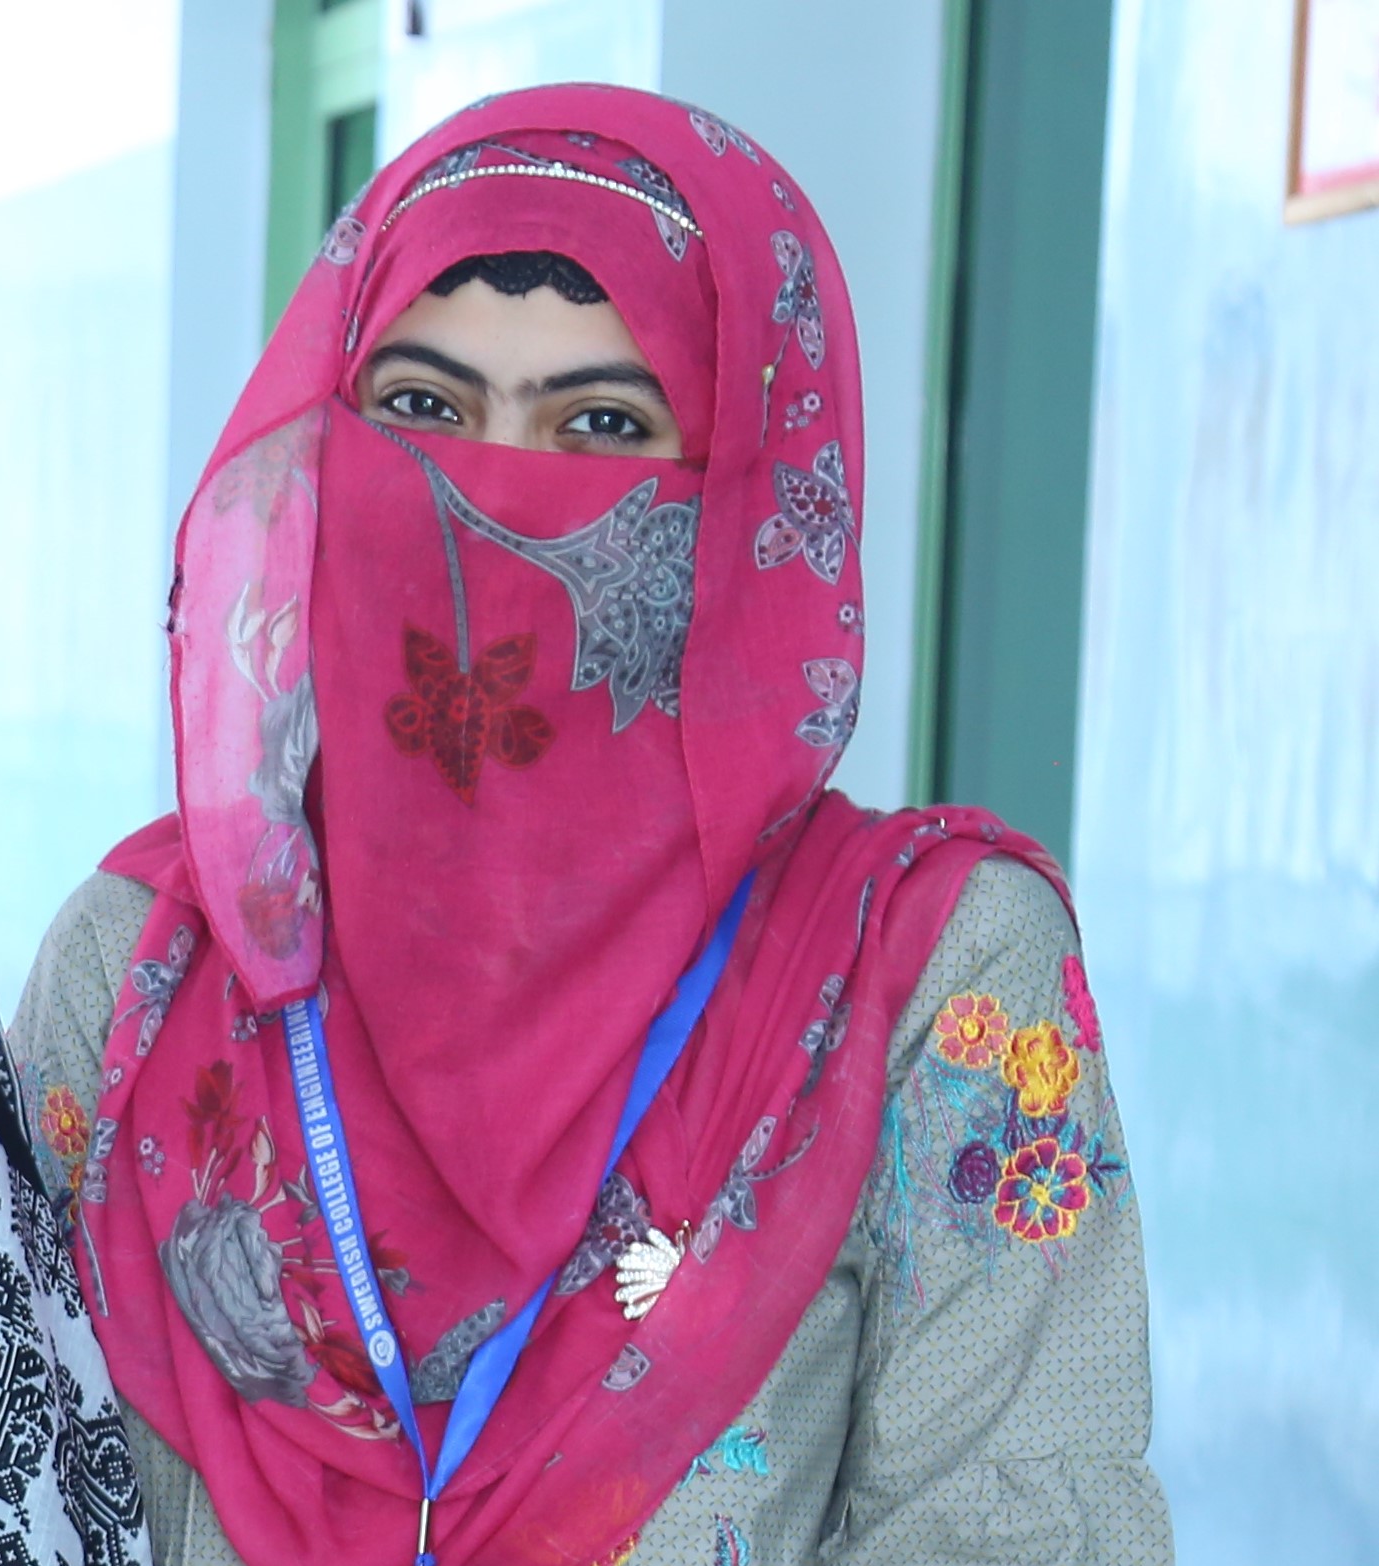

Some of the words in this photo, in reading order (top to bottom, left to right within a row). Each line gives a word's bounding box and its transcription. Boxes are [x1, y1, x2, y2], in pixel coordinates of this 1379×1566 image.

[308, 1123, 335, 1150] OF
[315, 1148, 354, 1235] COLLEGE
[338, 1234, 384, 1331] SWEDISH
